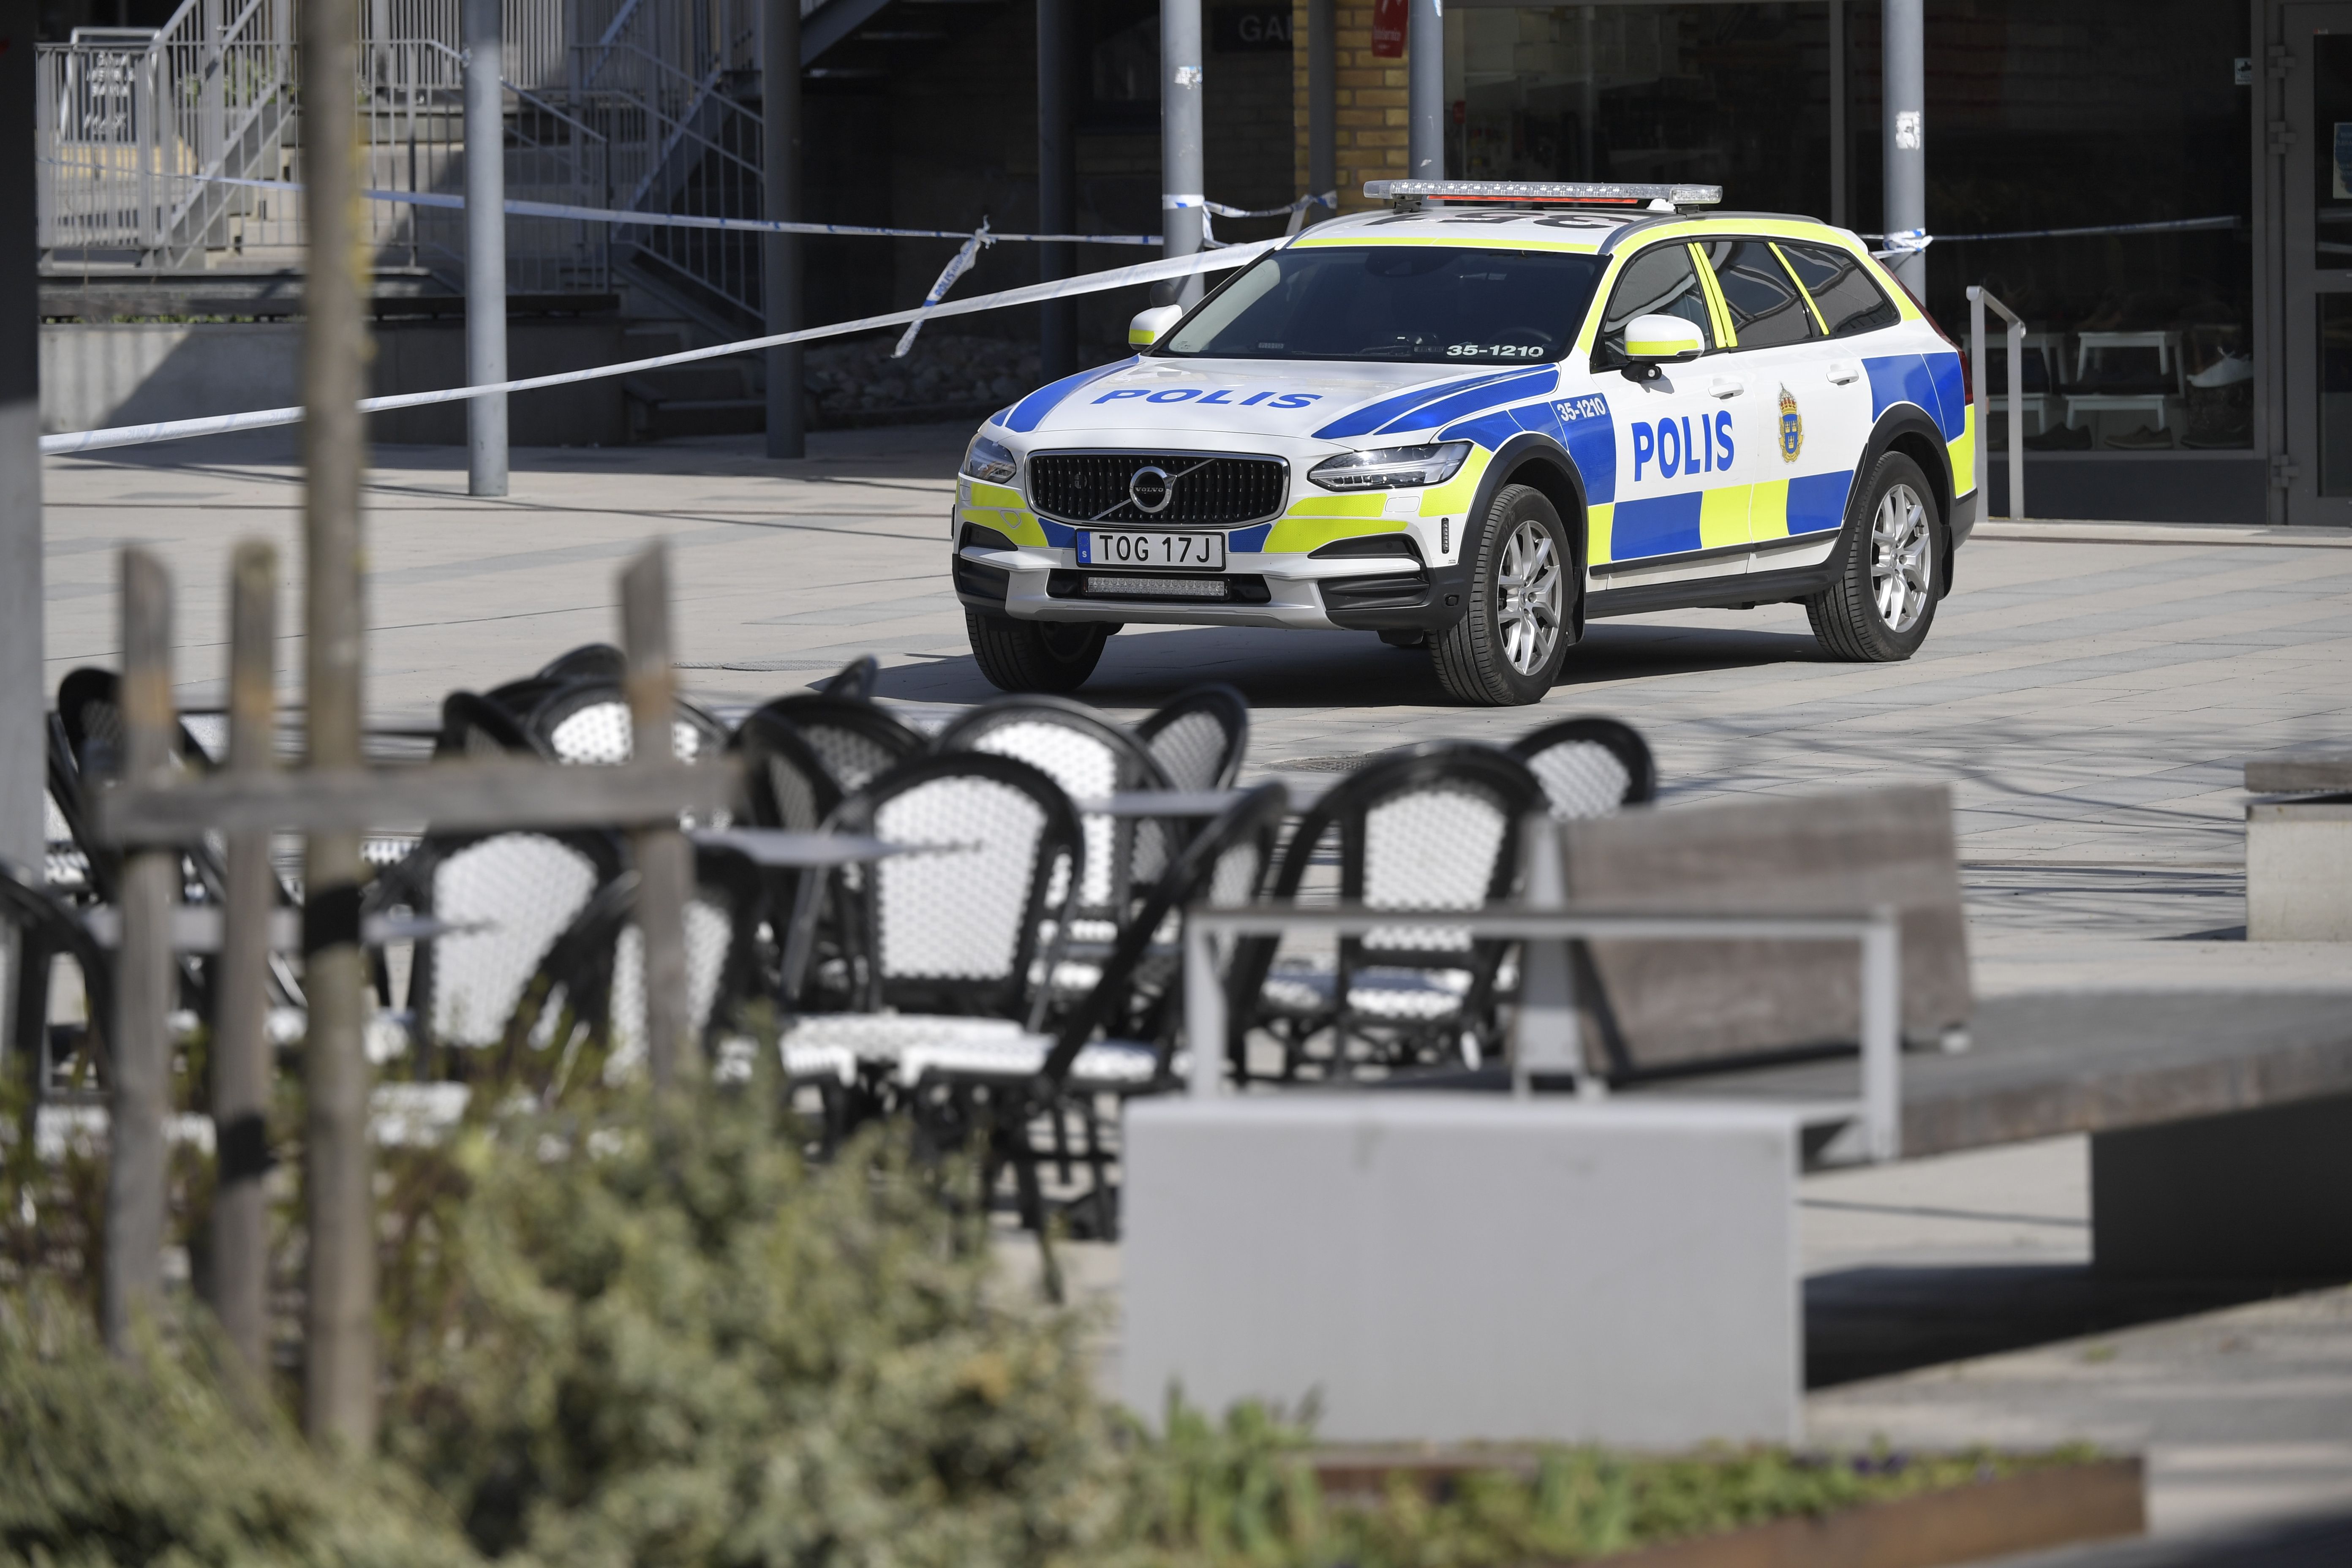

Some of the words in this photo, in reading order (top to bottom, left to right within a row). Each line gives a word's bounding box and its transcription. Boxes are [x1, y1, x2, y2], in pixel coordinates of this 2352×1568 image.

[935, 270, 956, 297] POLIS
[1446, 345, 1544, 357] 35-1210
[1089, 389, 1324, 408] POLIS
[1557, 397, 1606, 421] 35-1210
[1631, 410, 1734, 482] POLIS
[1099, 535, 1148, 561] TOG
[1162, 537, 1209, 563] 17J
